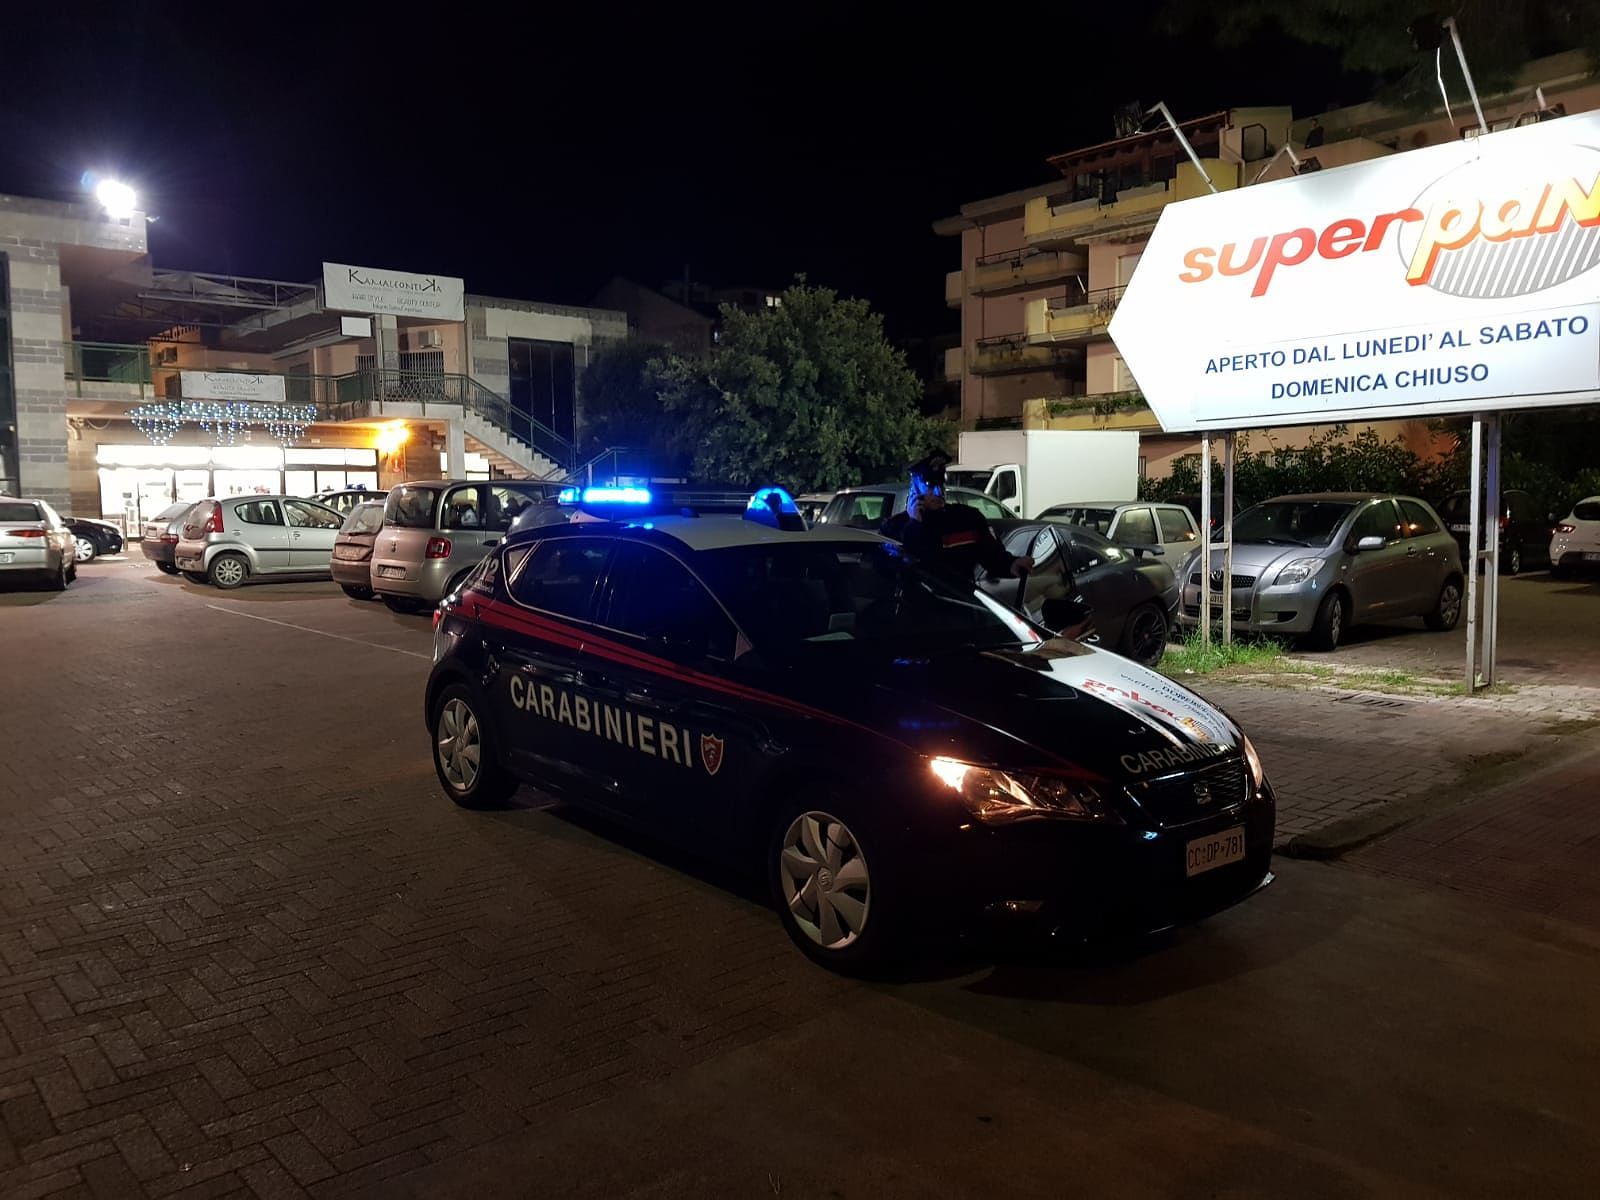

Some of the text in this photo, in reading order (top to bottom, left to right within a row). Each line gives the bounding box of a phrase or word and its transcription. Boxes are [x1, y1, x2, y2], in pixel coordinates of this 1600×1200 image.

[1205, 349, 1287, 374] APERTO
[1293, 345, 1336, 365] DAL
[1439, 329, 1472, 350] AL
[1479, 315, 1590, 345] SABATO
[1271, 363, 1490, 400] DOMENICA CHIUSO
[510, 675, 693, 768] CARABINIERI
